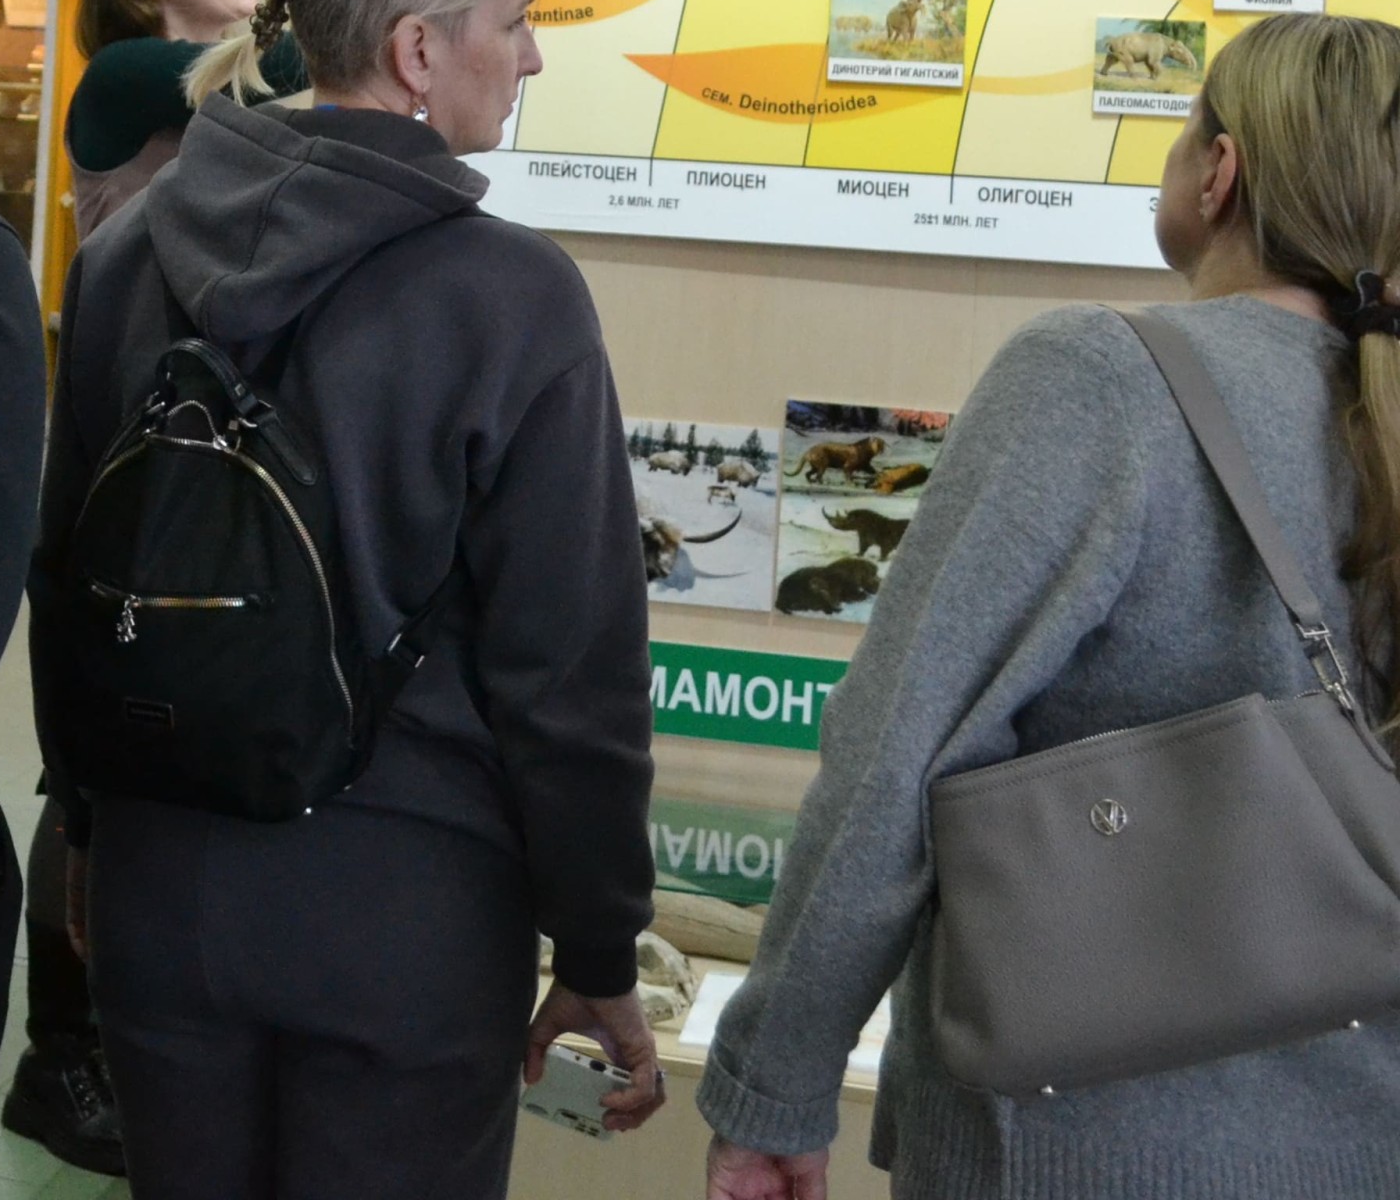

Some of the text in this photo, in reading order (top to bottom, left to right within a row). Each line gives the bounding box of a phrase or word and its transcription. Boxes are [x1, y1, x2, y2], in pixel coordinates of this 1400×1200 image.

[831, 62, 960, 80] ДИНОТЕРИЙ ГИГАНТСКИЙ
[739, 92, 879, 115] Deinotherioidea
[1098, 96, 1192, 112] ПАЛЕОМАСТОДОН
[528, 160, 1073, 208] ПЛЕЙСТОЦЕН ПЛИОЦЕН МИОЦЕН ОЛИГОЦЕН
[608, 194, 680, 210] 2,6 МЛН. ЛЕТ
[942, 214, 972, 227] МЛН.
[975, 216, 999, 229] ЛЕТ
